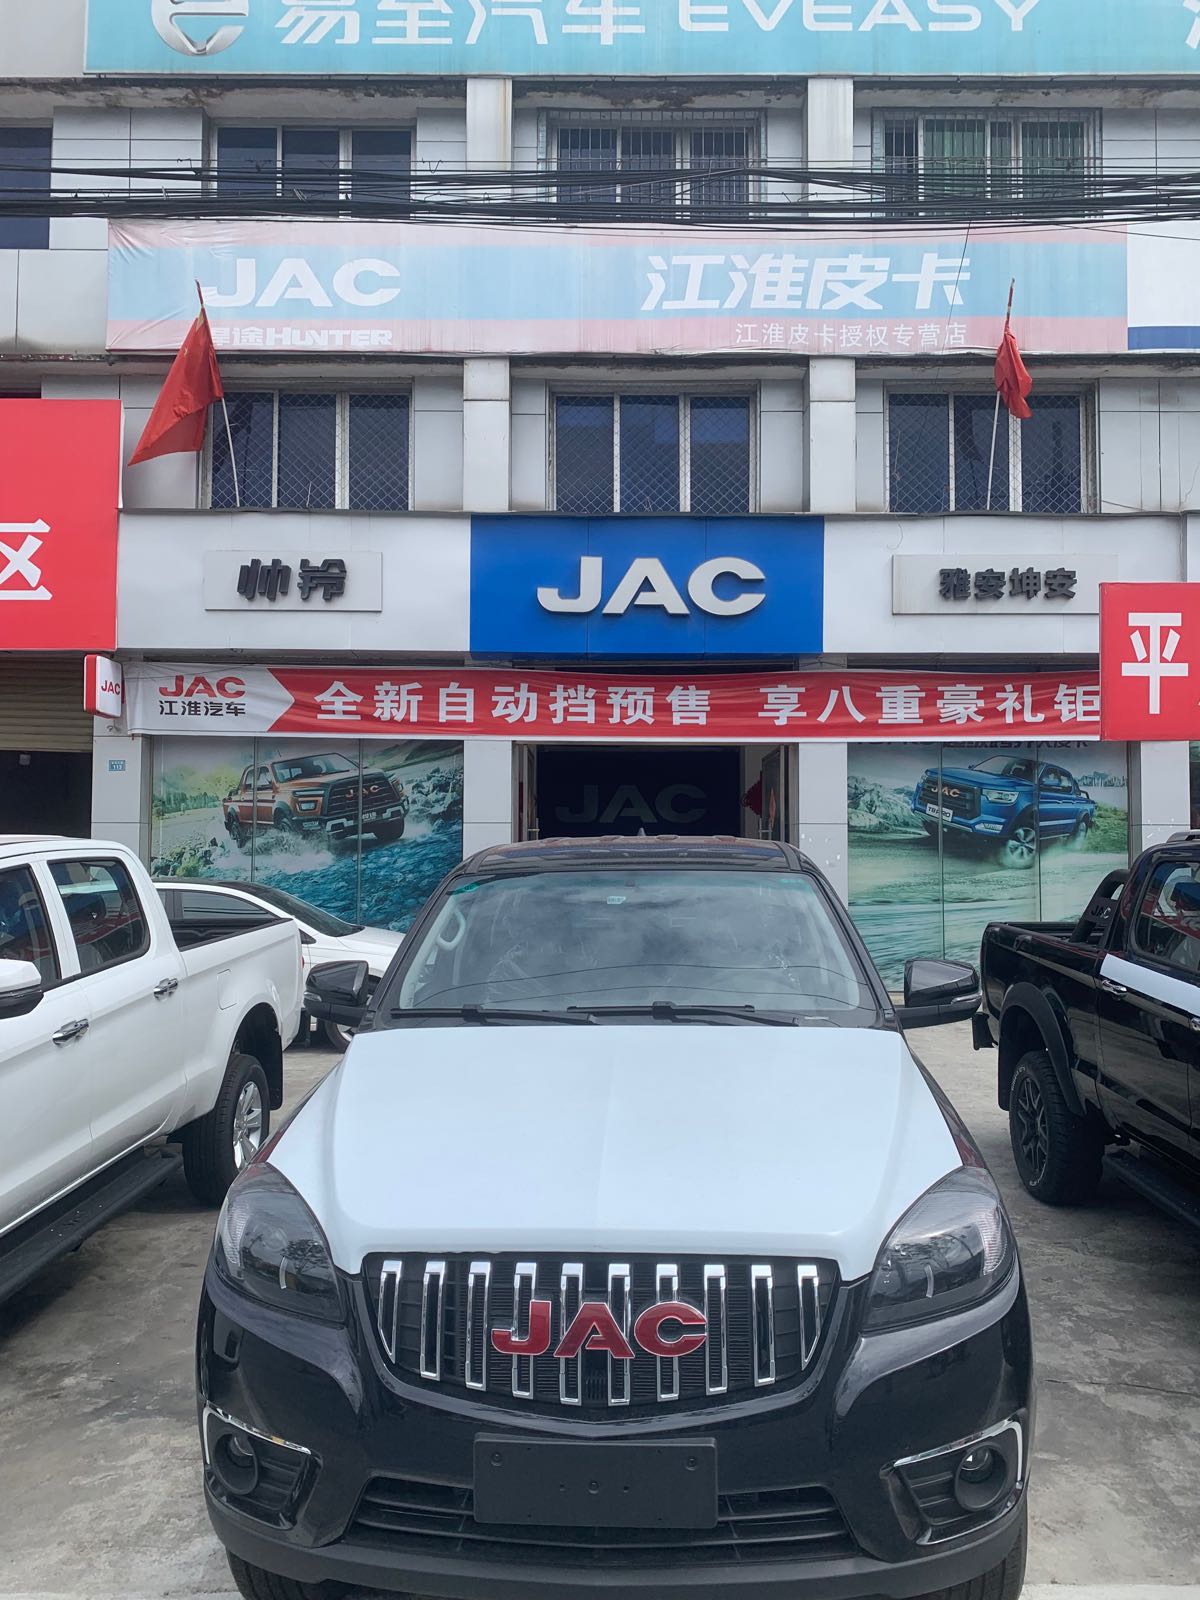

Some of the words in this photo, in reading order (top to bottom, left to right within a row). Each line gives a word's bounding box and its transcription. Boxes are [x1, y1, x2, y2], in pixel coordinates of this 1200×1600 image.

[678, 0, 1041, 32] EVEASY
[200, 258, 401, 307] JAC
[640, 253, 971, 311] 江淮皮卡
[735, 322, 967, 347] 江淮皮卡授权专营店
[237, 558, 347, 601] 帅铃
[536, 556, 766, 616] JAC
[939, 567, 1078, 600] 雅安坤安
[1121, 612, 1189, 715] 平
[101, 680, 121, 696] JAC
[159, 674, 246, 699] JAC
[314, 680, 711, 726] 全新自动挡预售
[757, 683, 1101, 726] 享八重豪礼钜
[159, 700, 246, 717] 江淮汽车
[555, 783, 707, 824] JAC
[491, 1300, 708, 1358] JAC
